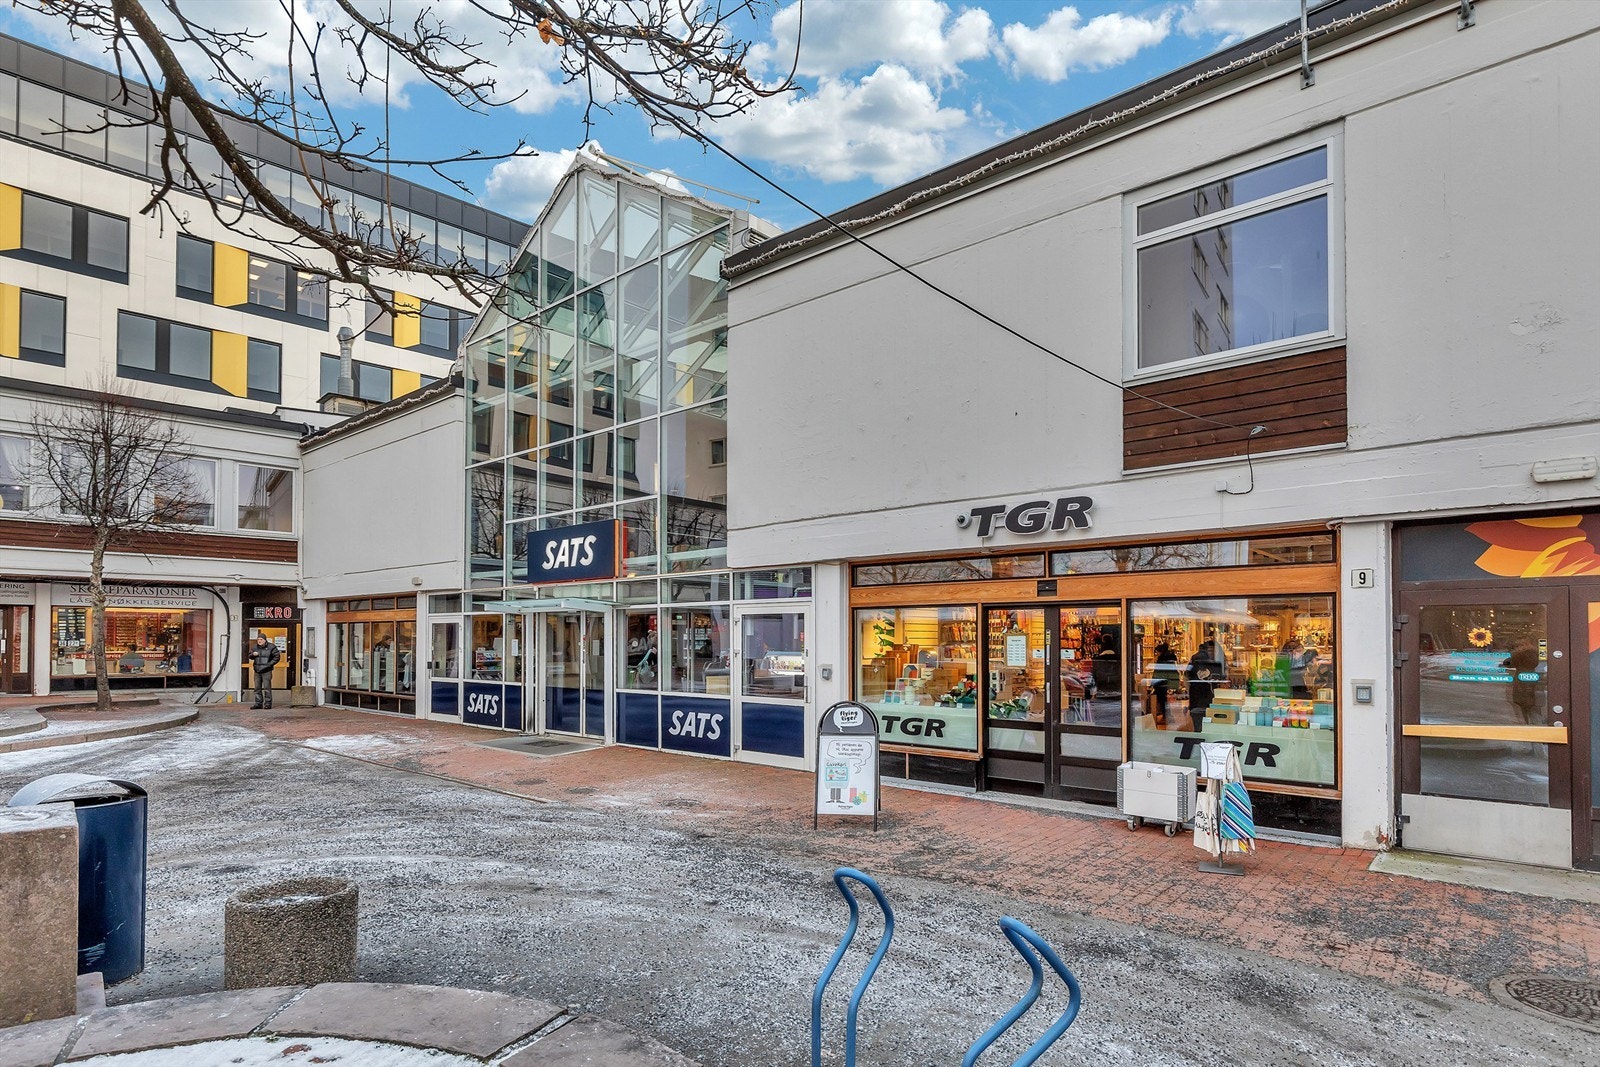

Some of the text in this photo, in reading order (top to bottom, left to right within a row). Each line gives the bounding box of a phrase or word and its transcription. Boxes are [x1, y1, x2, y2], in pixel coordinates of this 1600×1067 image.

[970, 496, 1094, 538] TGR
[541, 535, 597, 570] SATS
[1359, 572, 1366, 585] 9
[109, 598, 197, 606] NØKKELSERVICE
[265, 606, 292, 618] KRO
[467, 692, 500, 715] SATS
[668, 710, 724, 740] SATS
[881, 715, 946, 738] TGR
